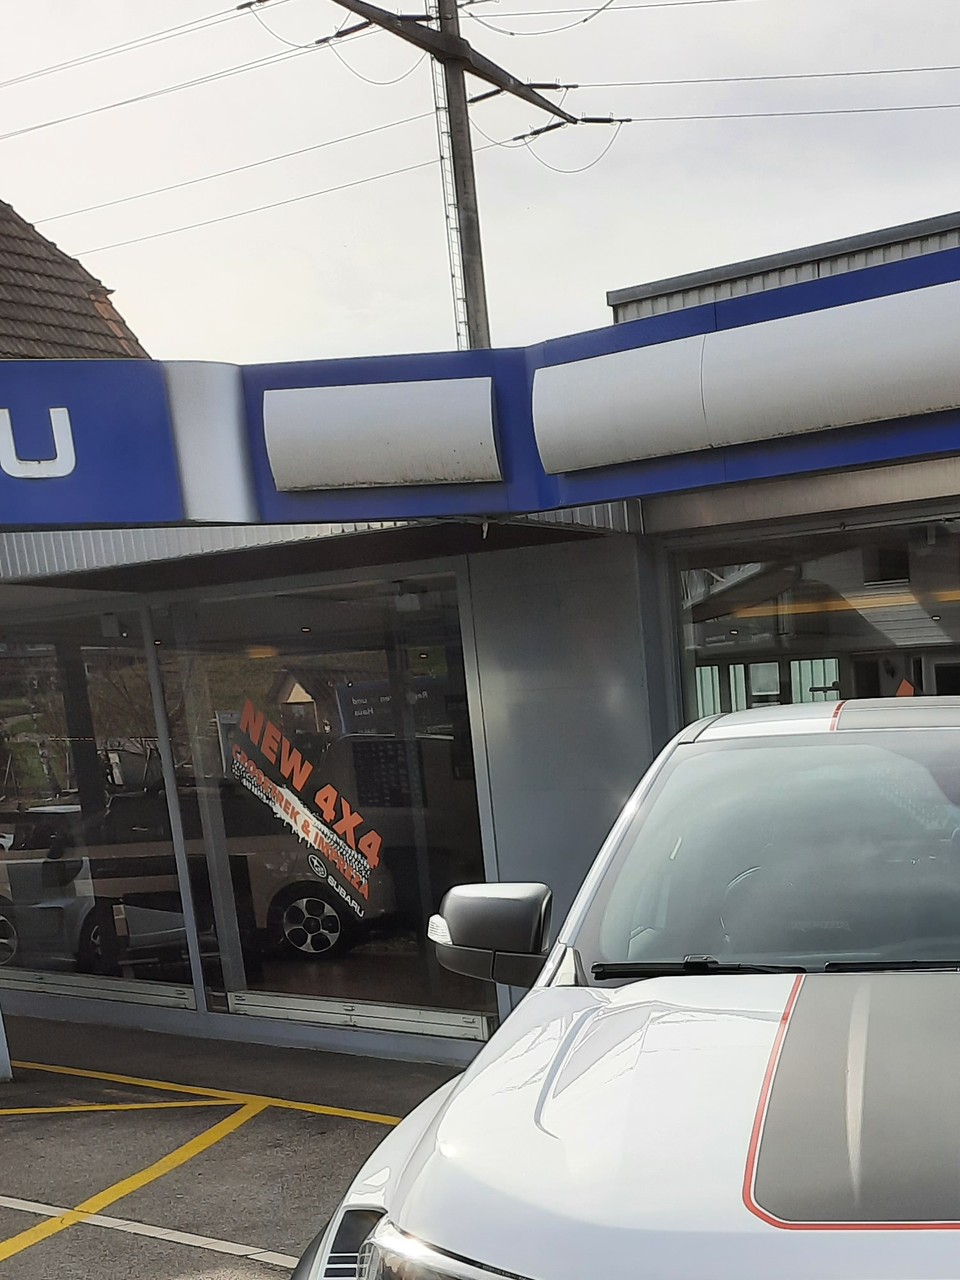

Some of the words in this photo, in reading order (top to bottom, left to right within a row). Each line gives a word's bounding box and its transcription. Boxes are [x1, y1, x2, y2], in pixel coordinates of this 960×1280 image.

[0, 407, 76, 478] U
[231, 743, 301, 823] CROSSTREK
[300, 820, 313, 838] &
[312, 830, 371, 901] IMPREZA
[240, 698, 314, 792] NEW
[314, 783, 383, 869] 4X4
[326, 875, 366, 918] SUBARU
